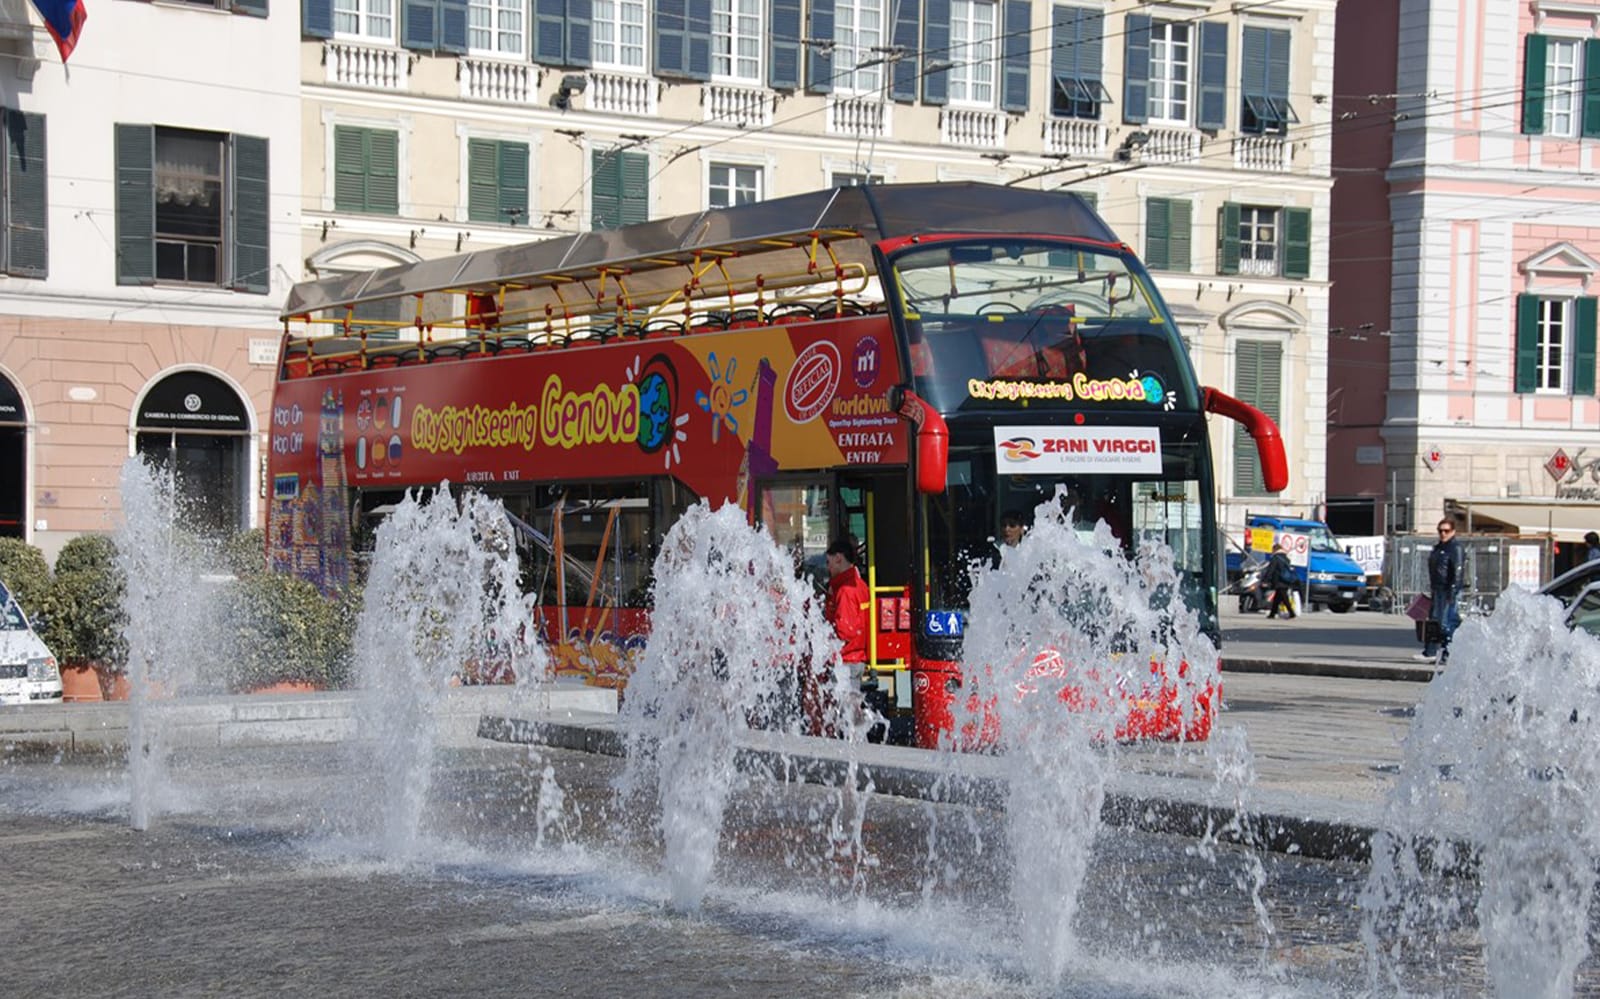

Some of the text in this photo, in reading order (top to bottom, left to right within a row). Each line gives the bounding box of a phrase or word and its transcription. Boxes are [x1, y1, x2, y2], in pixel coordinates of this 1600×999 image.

[794, 362, 829, 398] OFFICIAL
[968, 373, 1146, 401] CitySightseeing Genova
[274, 404, 304, 427] Hop On
[410, 373, 640, 455] CitySightseeing Genova
[832, 394, 888, 415] Worldwi
[273, 432, 303, 455] Hop Off
[838, 432, 894, 447] ENTRATA
[1042, 439, 1156, 454] ZANI VIAGGI
[847, 451, 881, 463] ENTRY
[503, 470, 520, 481] EXIT
